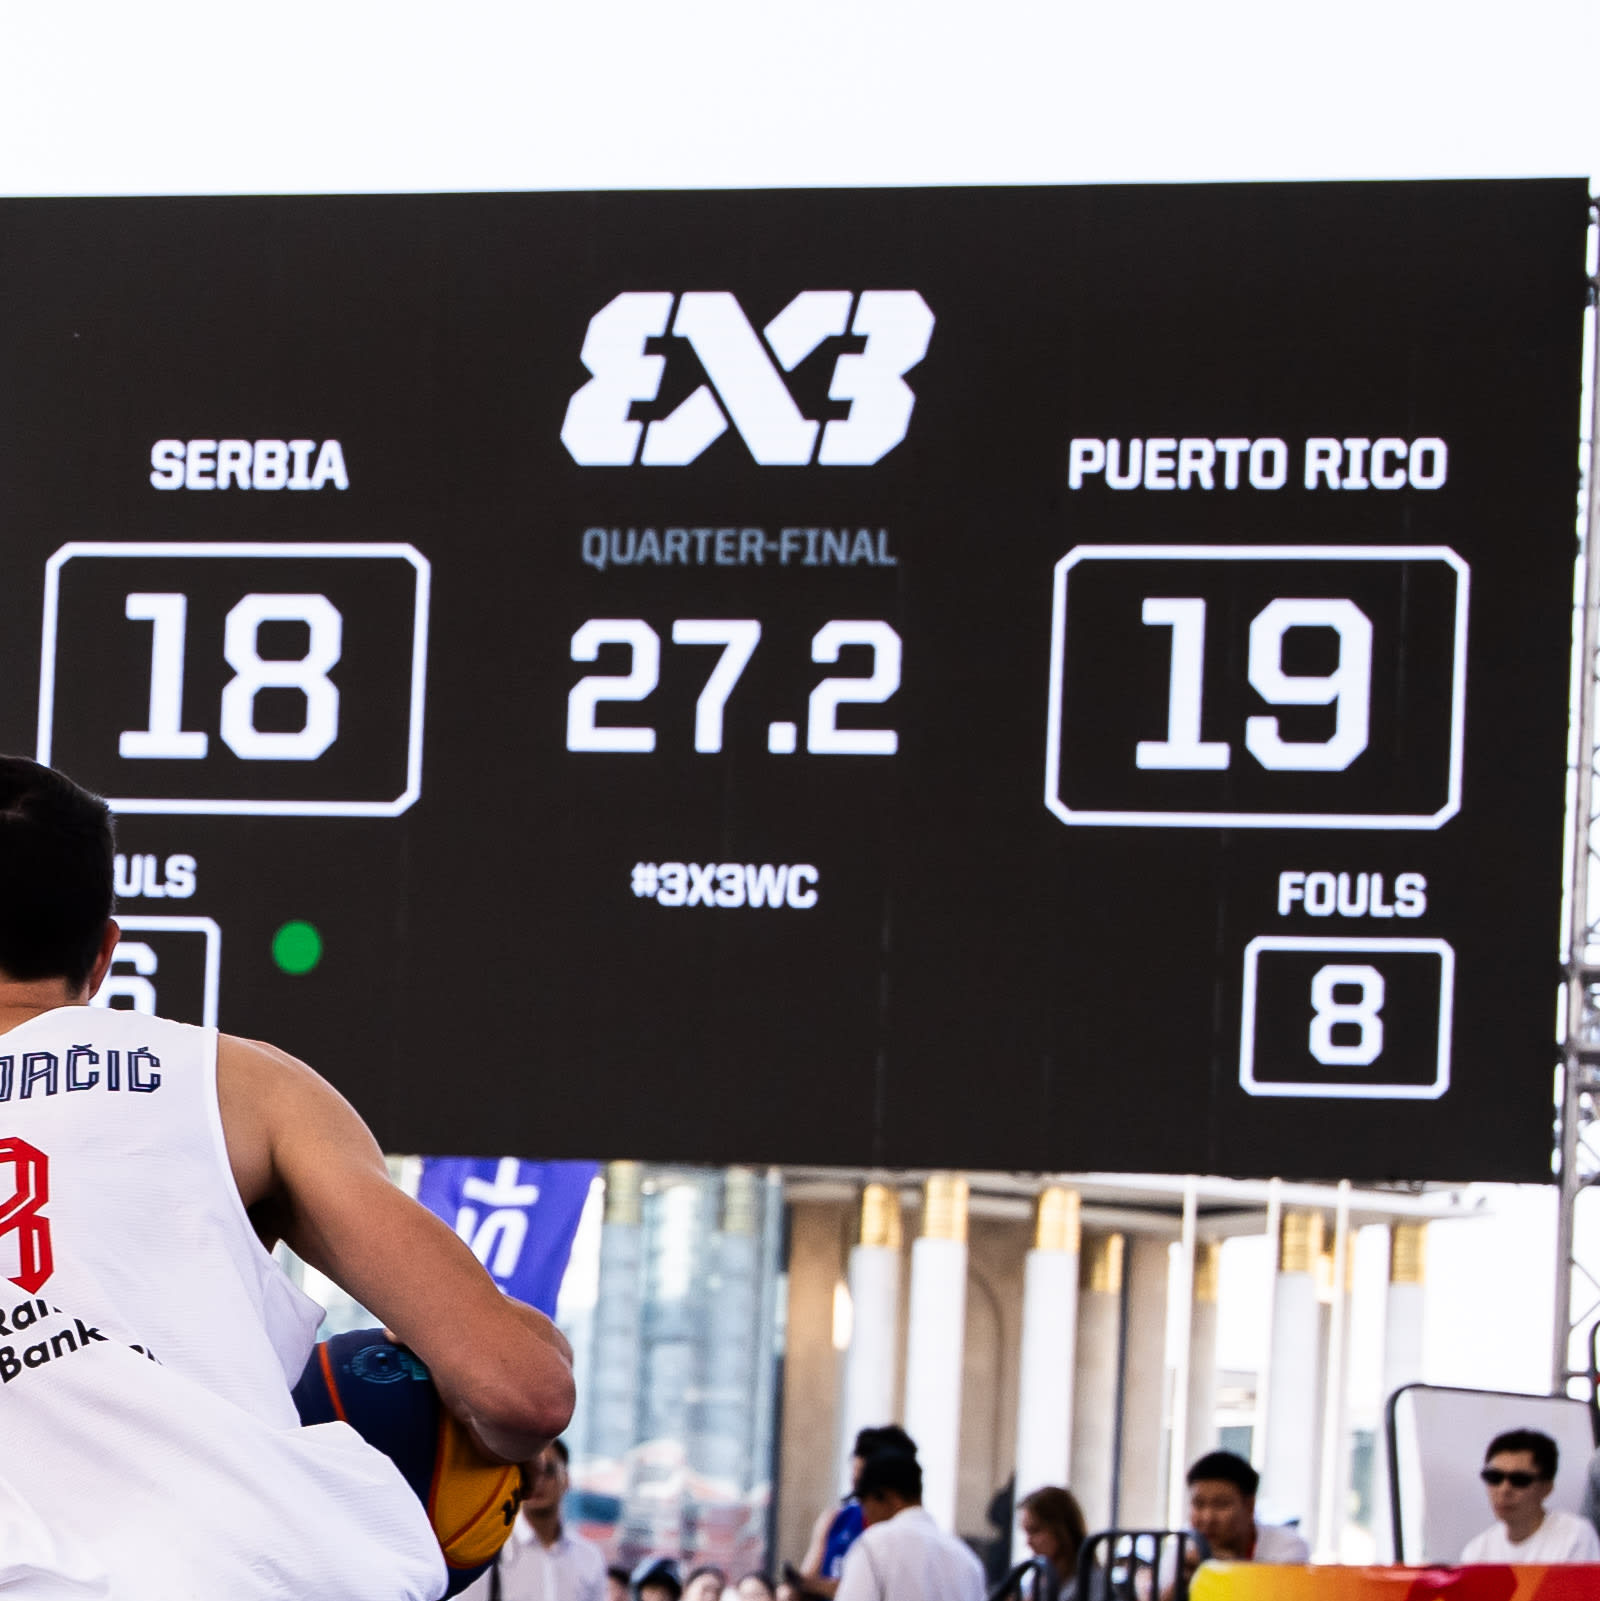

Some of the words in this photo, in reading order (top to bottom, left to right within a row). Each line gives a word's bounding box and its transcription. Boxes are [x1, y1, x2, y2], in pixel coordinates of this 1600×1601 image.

[150, 439, 349, 490] SERBIA
[1068, 437, 1288, 491] PUERTO
[1304, 437, 1449, 491] RICO
[582, 527, 898, 571] QUARTER-FINAL
[119, 593, 343, 760] 18
[566, 618, 902, 754] 27.2
[1136, 597, 1374, 771] 19
[113, 853, 197, 899] ULS
[631, 861, 819, 908] #3X3WC
[1277, 871, 1428, 918] FOULS
[1309, 964, 1385, 1065] 8
